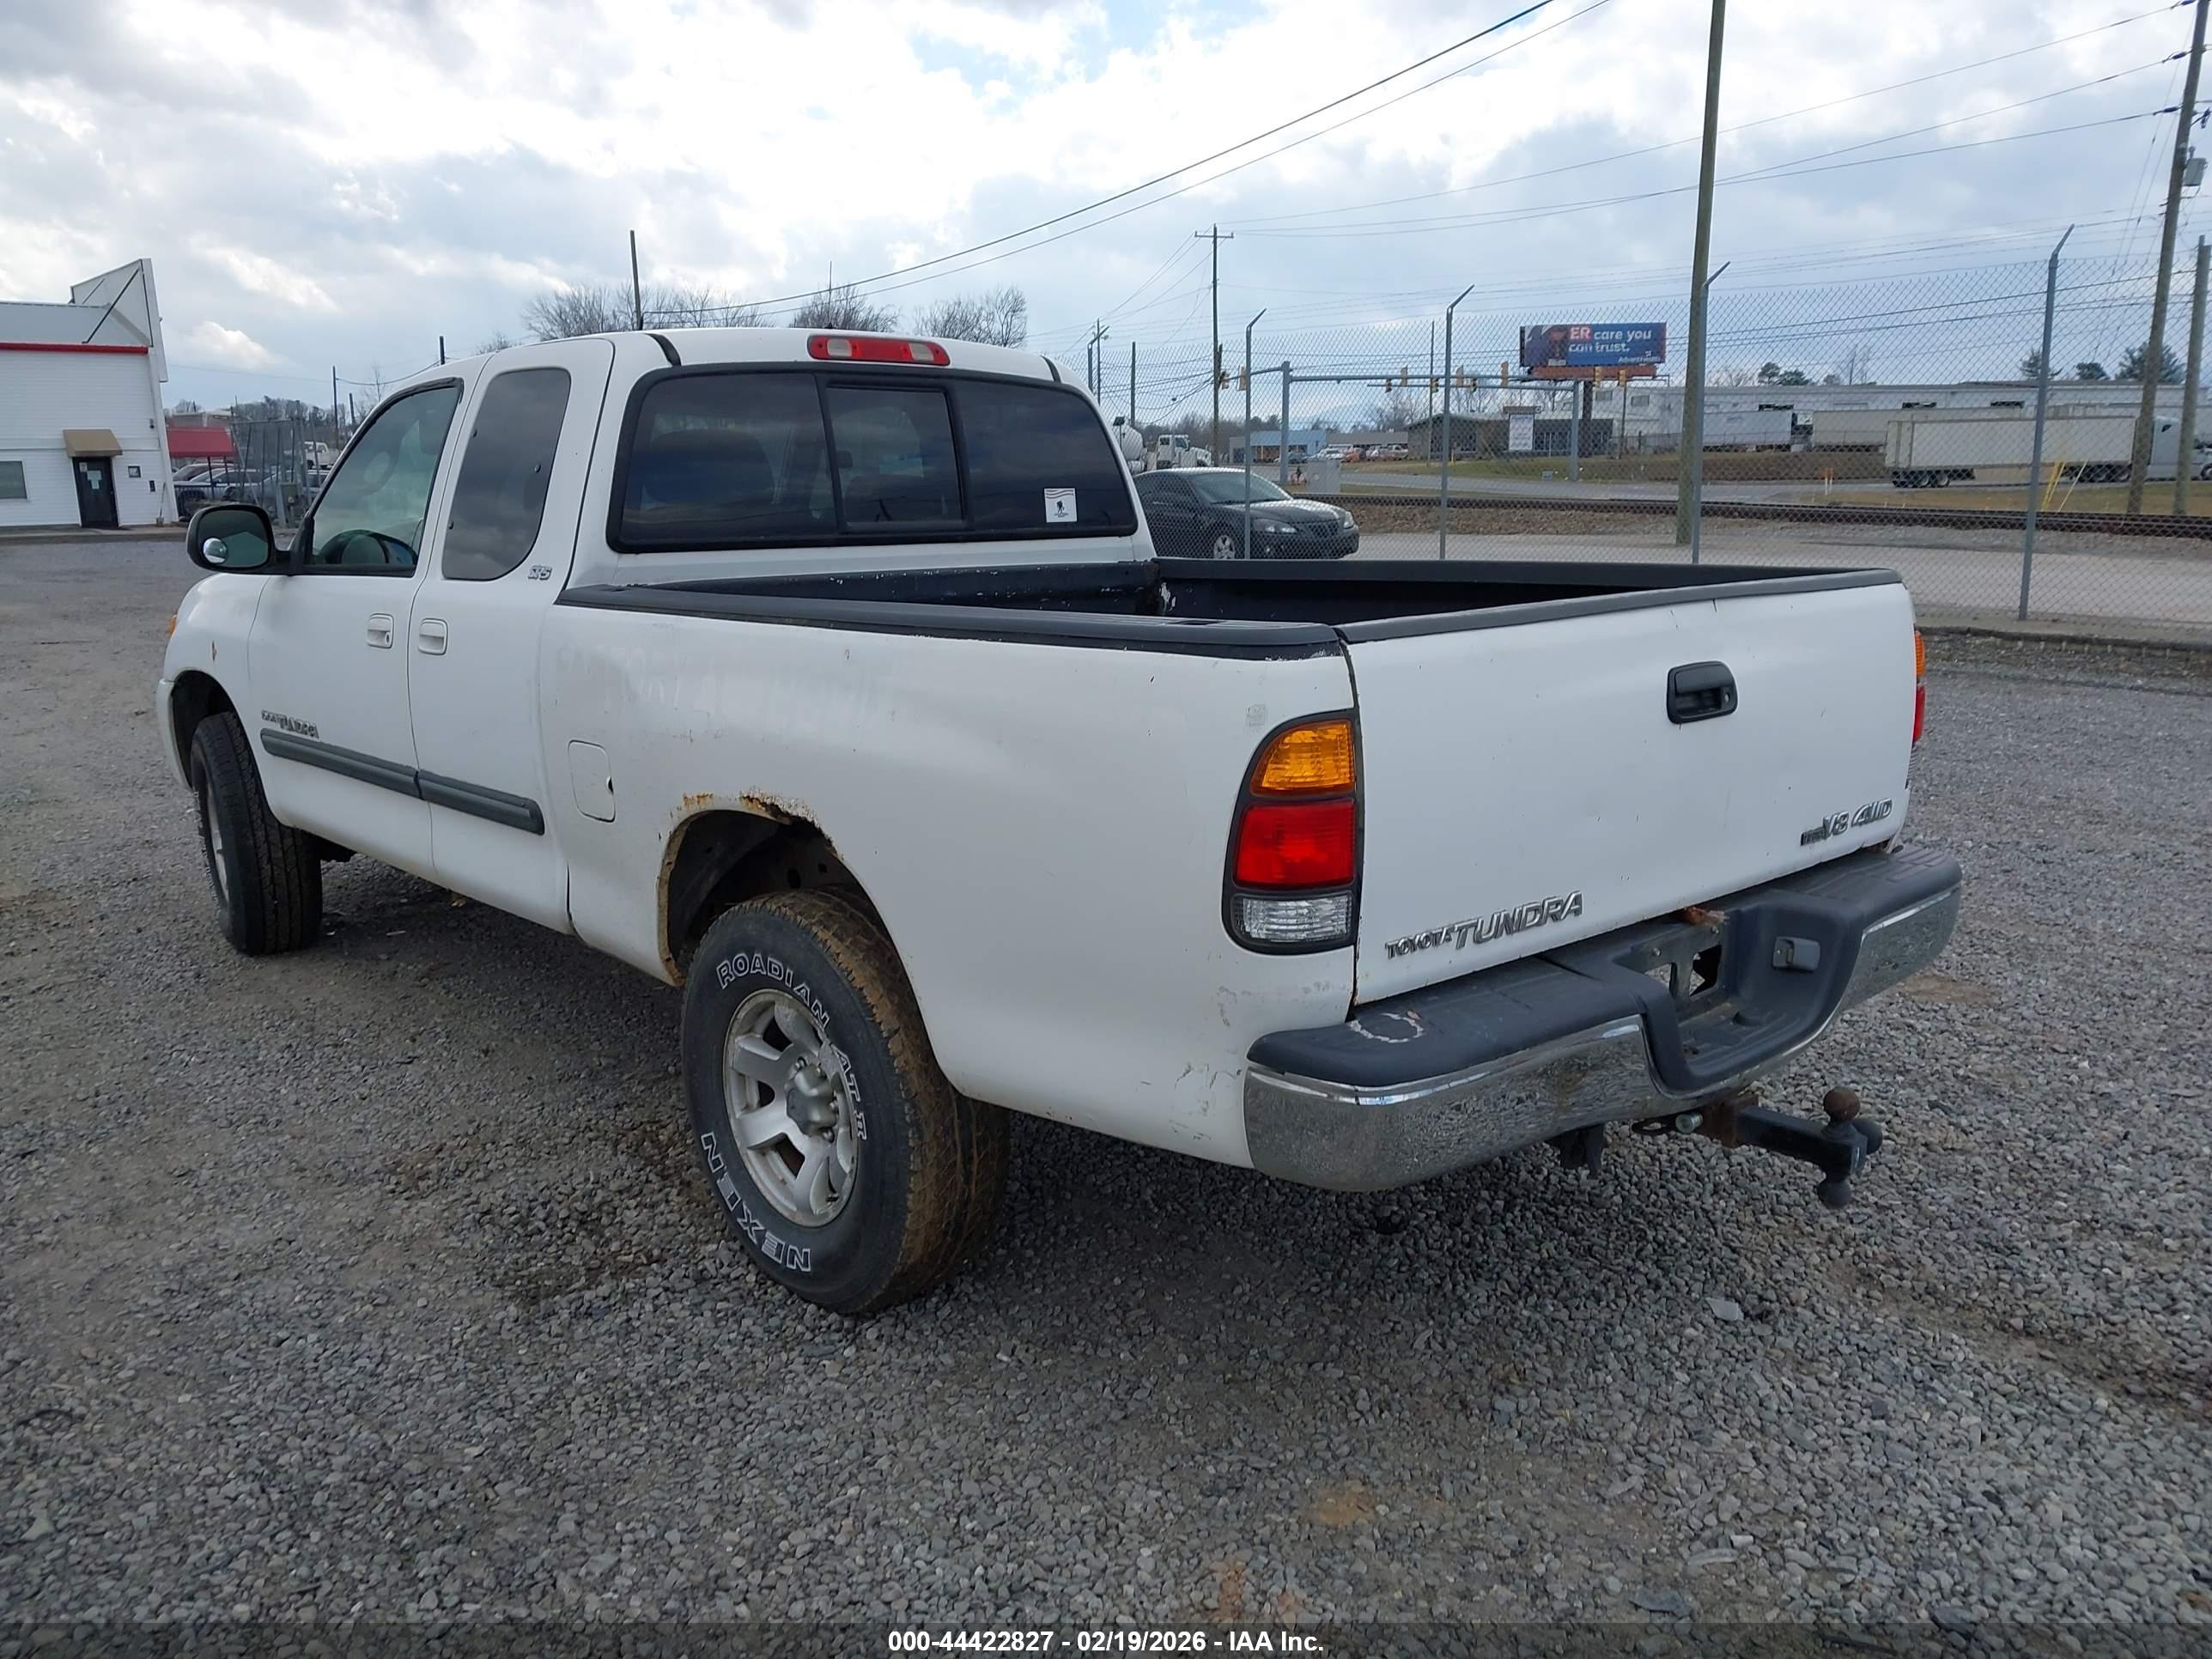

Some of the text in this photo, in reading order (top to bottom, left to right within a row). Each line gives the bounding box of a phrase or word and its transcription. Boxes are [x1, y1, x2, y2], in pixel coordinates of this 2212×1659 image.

[1569, 342, 1631, 353] can trust.
[1570, 326, 1652, 343] ER care you
[1823, 811, 1849, 840] V8
[1851, 798, 1893, 827] 4WD
[1385, 890, 1583, 959] TOYOTA TUNDRA
[716, 952, 830, 1030] ROADIAN
[700, 1131, 811, 1273] NEXEN
